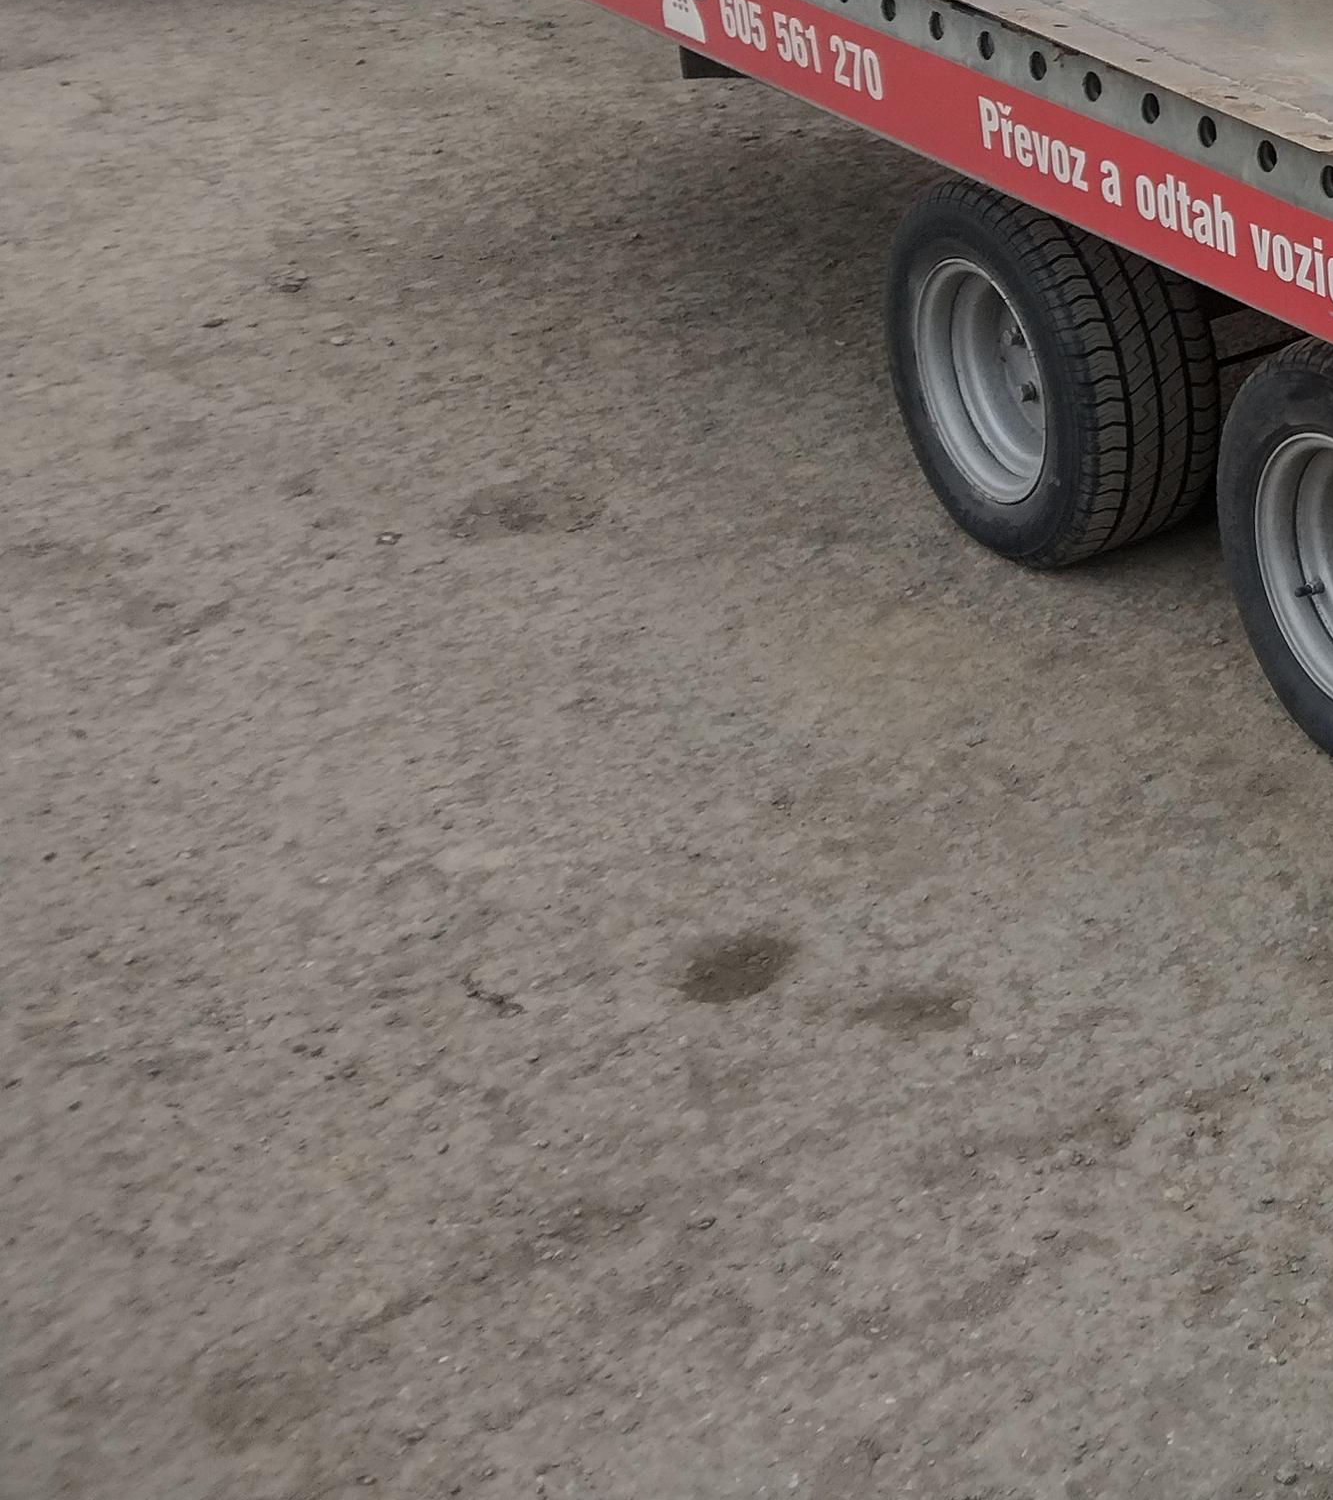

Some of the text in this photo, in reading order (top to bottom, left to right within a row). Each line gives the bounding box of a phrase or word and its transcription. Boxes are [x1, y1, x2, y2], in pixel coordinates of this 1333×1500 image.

[773, 11, 821, 73] 561
[830, 35, 883, 100] 270
[978, 95, 1089, 192] Převoz
[1101, 160, 1122, 206] a
[1135, 173, 1236, 257] odtah
